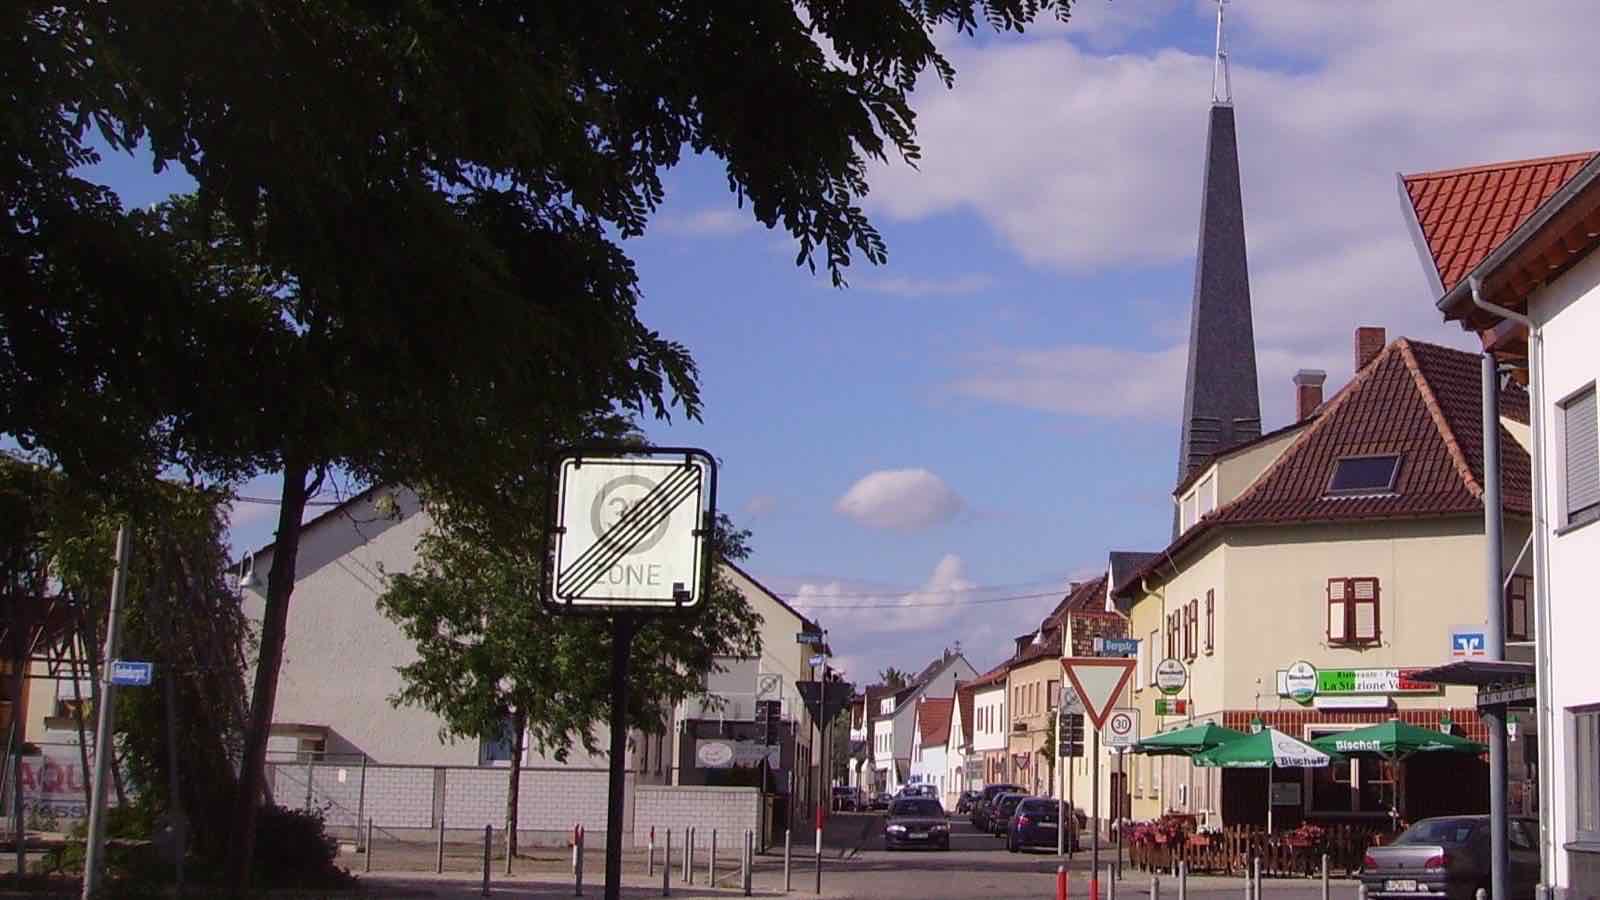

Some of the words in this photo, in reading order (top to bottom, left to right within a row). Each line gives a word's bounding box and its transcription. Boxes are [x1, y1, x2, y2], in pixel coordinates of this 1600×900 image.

[1339, 680, 1386, 691] Stazione
[1115, 718, 1128, 729] 30
[1334, 740, 1381, 751] Bischoff
[1280, 756, 1325, 767] Bischoff
